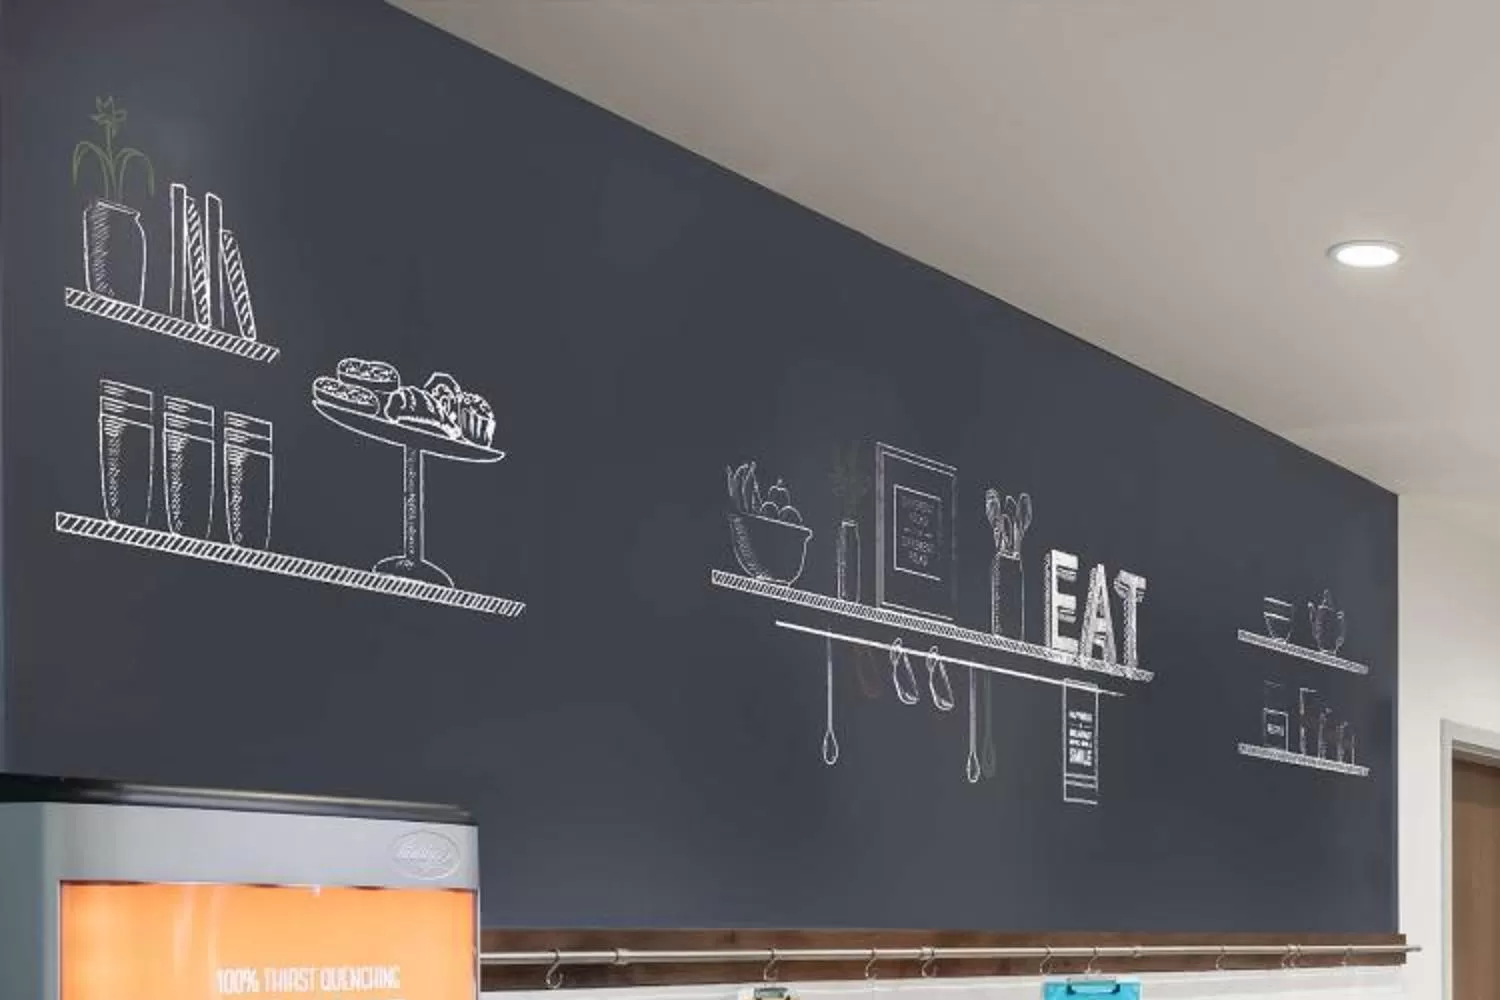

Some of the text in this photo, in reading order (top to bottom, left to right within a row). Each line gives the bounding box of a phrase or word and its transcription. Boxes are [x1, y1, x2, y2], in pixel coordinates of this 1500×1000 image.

[1044, 549, 1147, 667] EAT
[217, 965, 401, 993] 100% THIRST QUENCHING
